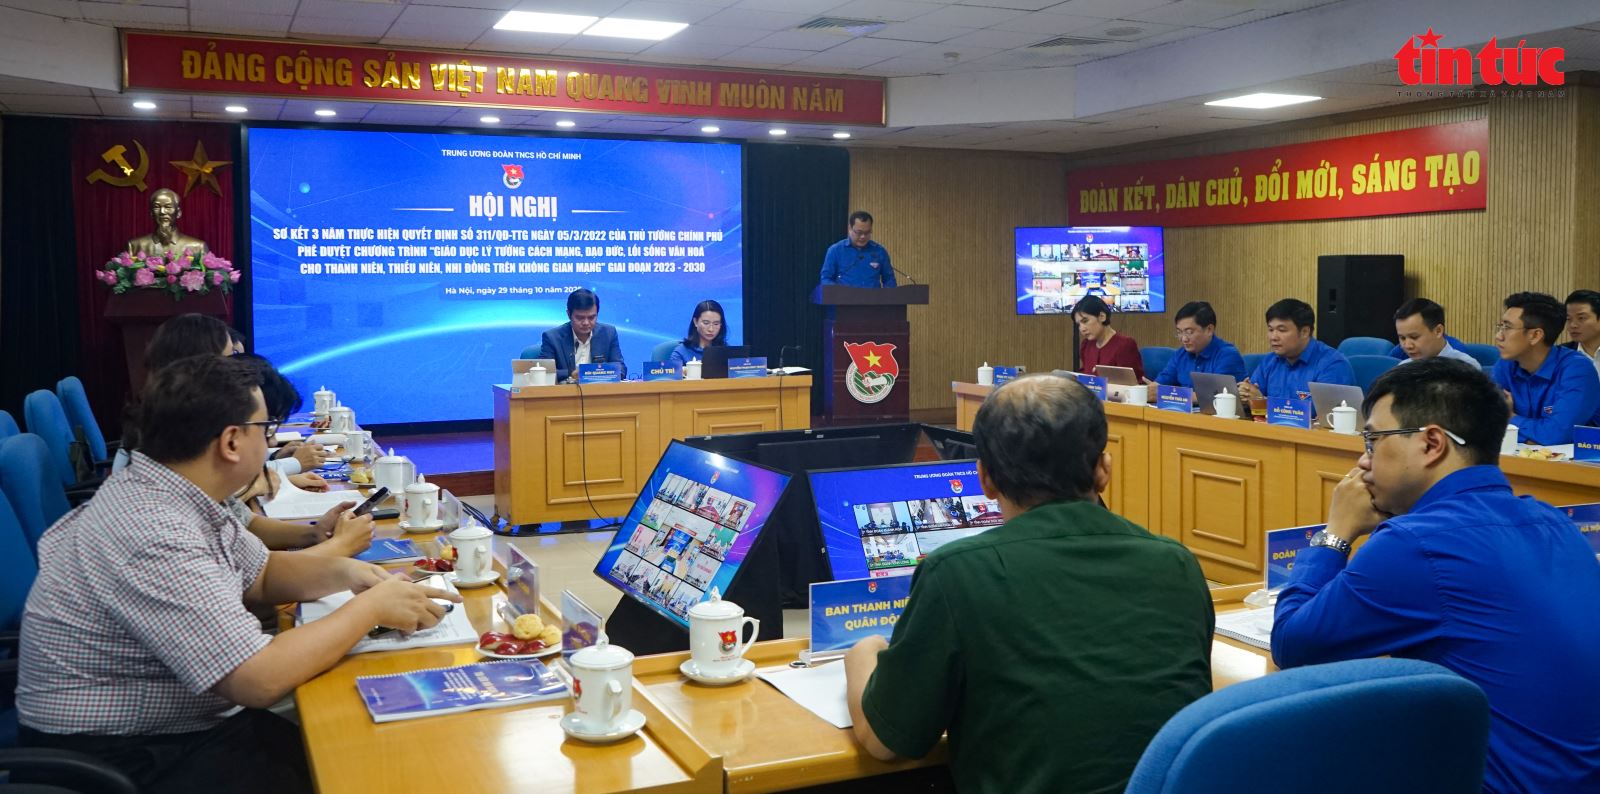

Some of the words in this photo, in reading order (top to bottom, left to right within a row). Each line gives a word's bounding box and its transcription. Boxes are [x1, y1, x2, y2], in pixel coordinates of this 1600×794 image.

[181, 41, 265, 82] ĐẢNG
[275, 49, 352, 90] CỘNG
[362, 51, 421, 90] SẢN
[430, 59, 488, 97] VIỆT
[496, 67, 557, 97] NAM
[566, 71, 649, 104] QUANG
[657, 80, 712, 107] VINH
[719, 80, 785, 110] MUÔN
[793, 82, 844, 113] NĂM
[442, 149, 467, 157] TRUNG
[469, 149, 491, 158] ƯƠNG
[493, 150, 514, 158] ĐOÀN
[536, 150, 546, 159] HỒ
[548, 151, 561, 160] CHÍ
[1079, 183, 1118, 215] ĐOÀN
[1123, 175, 1160, 213] KẾT,
[1166, 176, 1200, 209] DÂN
[1205, 167, 1248, 208] CHỦ,
[1255, 159, 1289, 203] ĐỔI
[1296, 159, 1344, 200] MỚI,
[1351, 154, 1417, 194] SÁNG
[1425, 151, 1480, 196] TẠO
[469, 192, 504, 221] HỘI
[510, 195, 558, 222] NGHỊ
[273, 228, 288, 240] SƠ
[291, 225, 309, 240] KẾT
[312, 228, 319, 240] 3
[322, 226, 344, 240] NĂM
[347, 228, 374, 242] THỰC
[377, 227, 400, 242] HIỆN
[402, 226, 432, 241] QUYẾT
[434, 230, 458, 242] ĐỊNH
[461, 226, 473, 240] SỐ
[476, 229, 528, 241] 311/QĐ-TTG
[531, 227, 555, 241] NGÀY
[557, 230, 606, 241] 05/3/2022
[609, 227, 626, 241] CỦA
[629, 227, 646, 241] THỦ
[648, 227, 676, 241] TƯỚNG
[678, 228, 704, 241] CHÍNH
[706, 228, 723, 242] PHỦ
[298, 244, 317, 256] PHÊ
[320, 243, 351, 258] DUYỆT
[354, 245, 395, 257] CHƯƠNG
[398, 243, 427, 256] TRÌNH
[460, 246, 478, 258] DỤC
[482, 244, 491, 256] LÝ
[495, 244, 525, 256] TƯỞNG
[528, 244, 552, 256] CÁCH
[555, 246, 582, 258] MẠNG,
[586, 246, 602, 258] ĐẠO
[628, 244, 640, 256] LỐI
[644, 244, 666, 256] SỐNG
[669, 244, 686, 256] VĂN
[688, 244, 704, 256] HOÁ
[300, 263, 322, 274] CHO
[324, 263, 358, 274] THANH
[361, 260, 385, 275] NIÊN,
[388, 260, 416, 274] THIẾU
[419, 260, 442, 275] NIÊN,
[445, 262, 462, 274] NHI
[464, 260, 490, 274] ĐỒNG
[493, 260, 516, 273] TRÊN
[518, 260, 550, 273] KHÔNG
[552, 262, 573, 272] GIAN
[608, 262, 626, 272] GIAI
[628, 262, 651, 274] ĐOẠN
[654, 262, 676, 272] 2023
[684, 262, 705, 272] 2030
[446, 286, 457, 294] Hà
[459, 286, 474, 296] Nội,
[476, 287, 496, 295] ngày
[510, 286, 532, 294] tháng
[825, 605, 850, 616] BAN
[852, 600, 891, 613] THANH
[894, 596, 911, 609] NIÊ
[845, 616, 877, 631] QUÂN
[880, 614, 901, 626] ĐỘ
